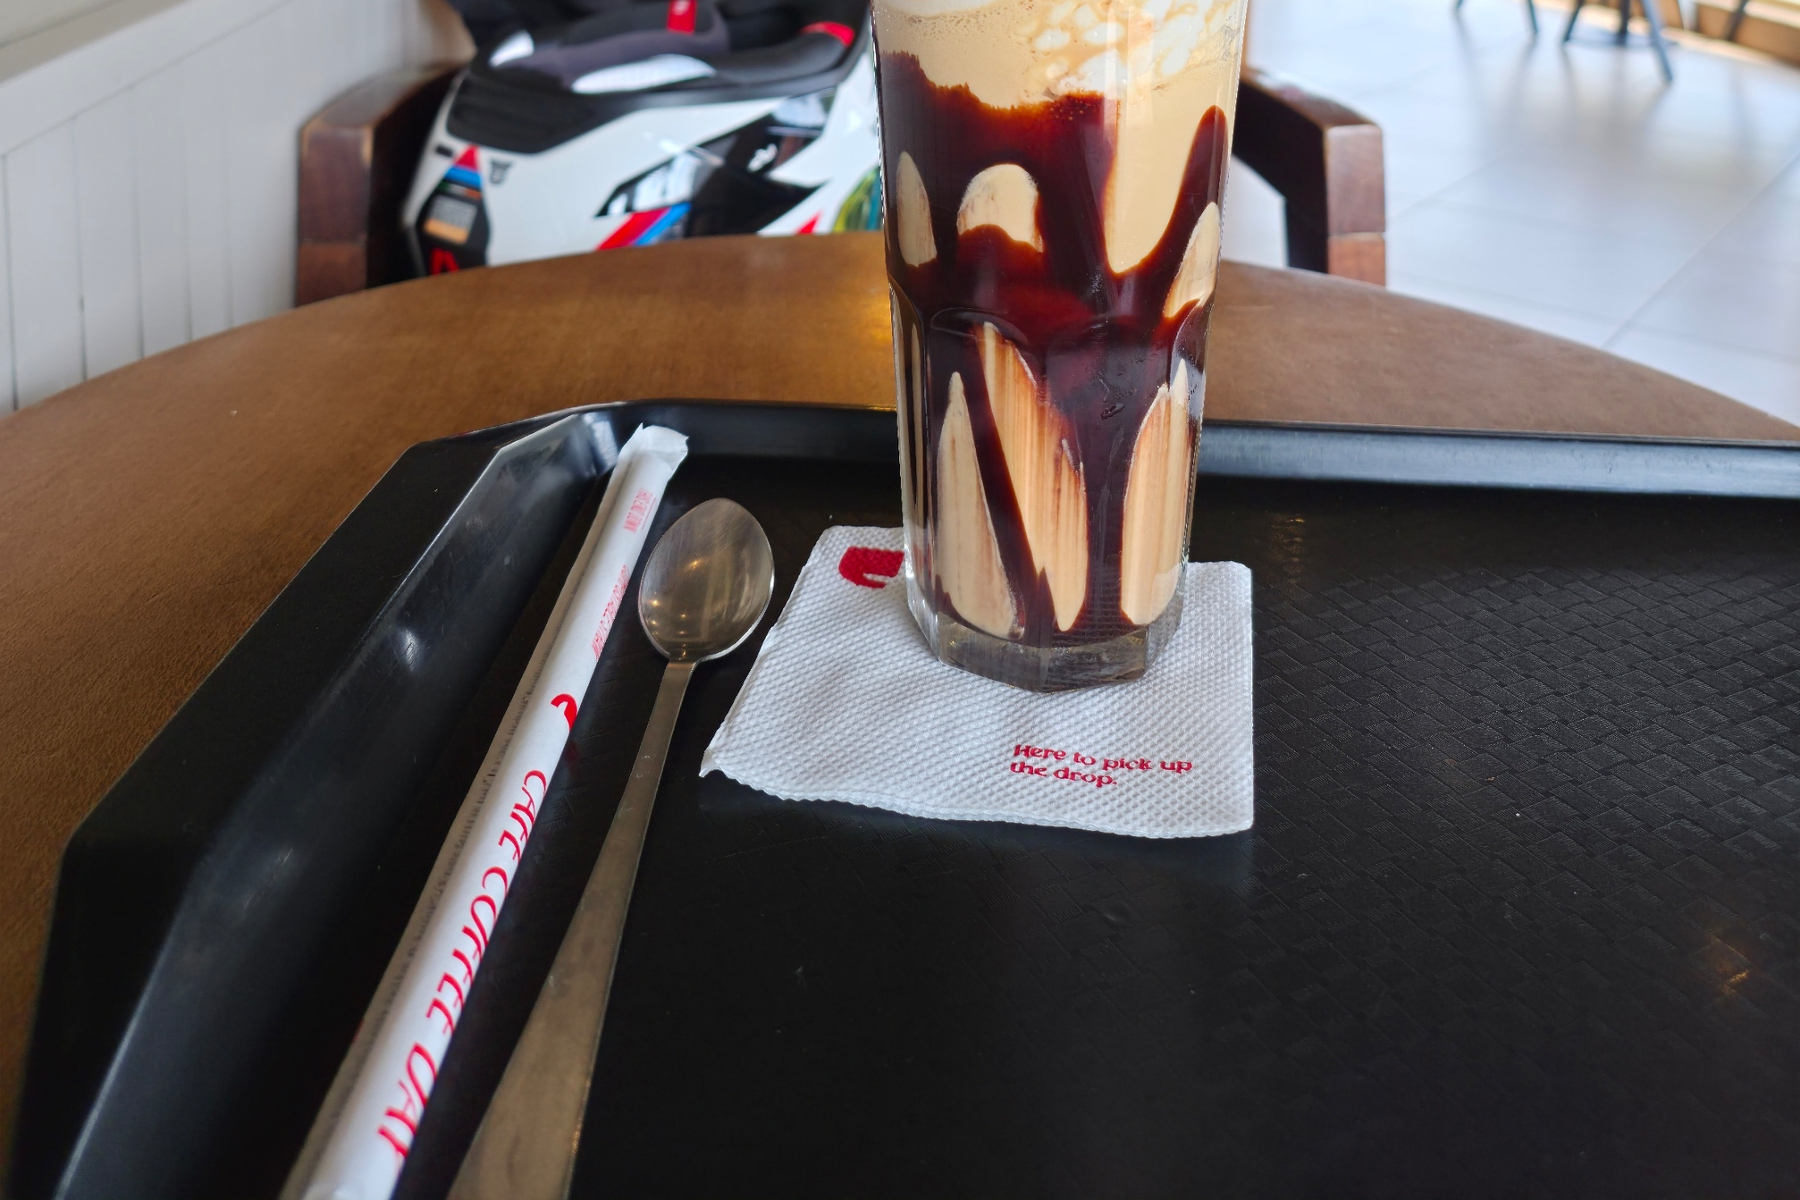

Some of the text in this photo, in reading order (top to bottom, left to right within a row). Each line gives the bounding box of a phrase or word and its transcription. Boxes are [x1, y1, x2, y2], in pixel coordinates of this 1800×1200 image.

[1012, 744, 1193, 774] Here to pick up
[1010, 761, 1118, 788] the drop.
[425, 866, 509, 1035] COFFEE
